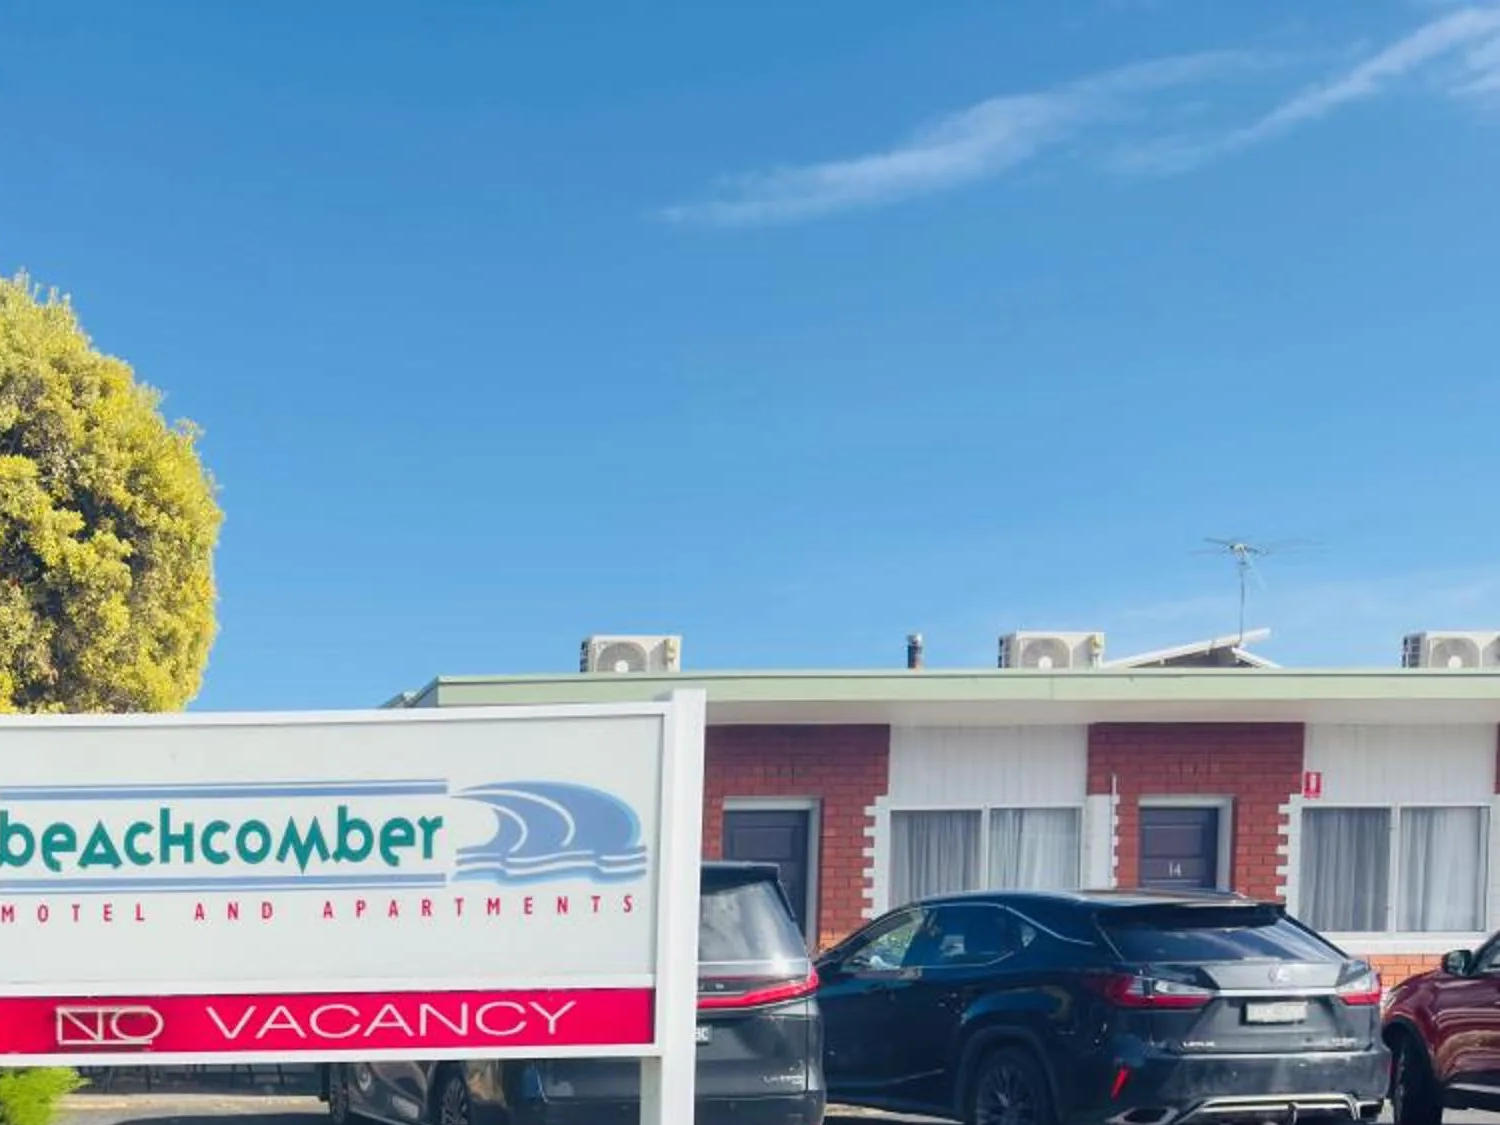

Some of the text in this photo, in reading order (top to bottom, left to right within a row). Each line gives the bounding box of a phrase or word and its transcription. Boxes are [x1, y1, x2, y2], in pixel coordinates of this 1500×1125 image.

[0, 895, 633, 923] MOTEL AND APARTMENTS
[56, 1000, 577, 1045] NO VACANCY
